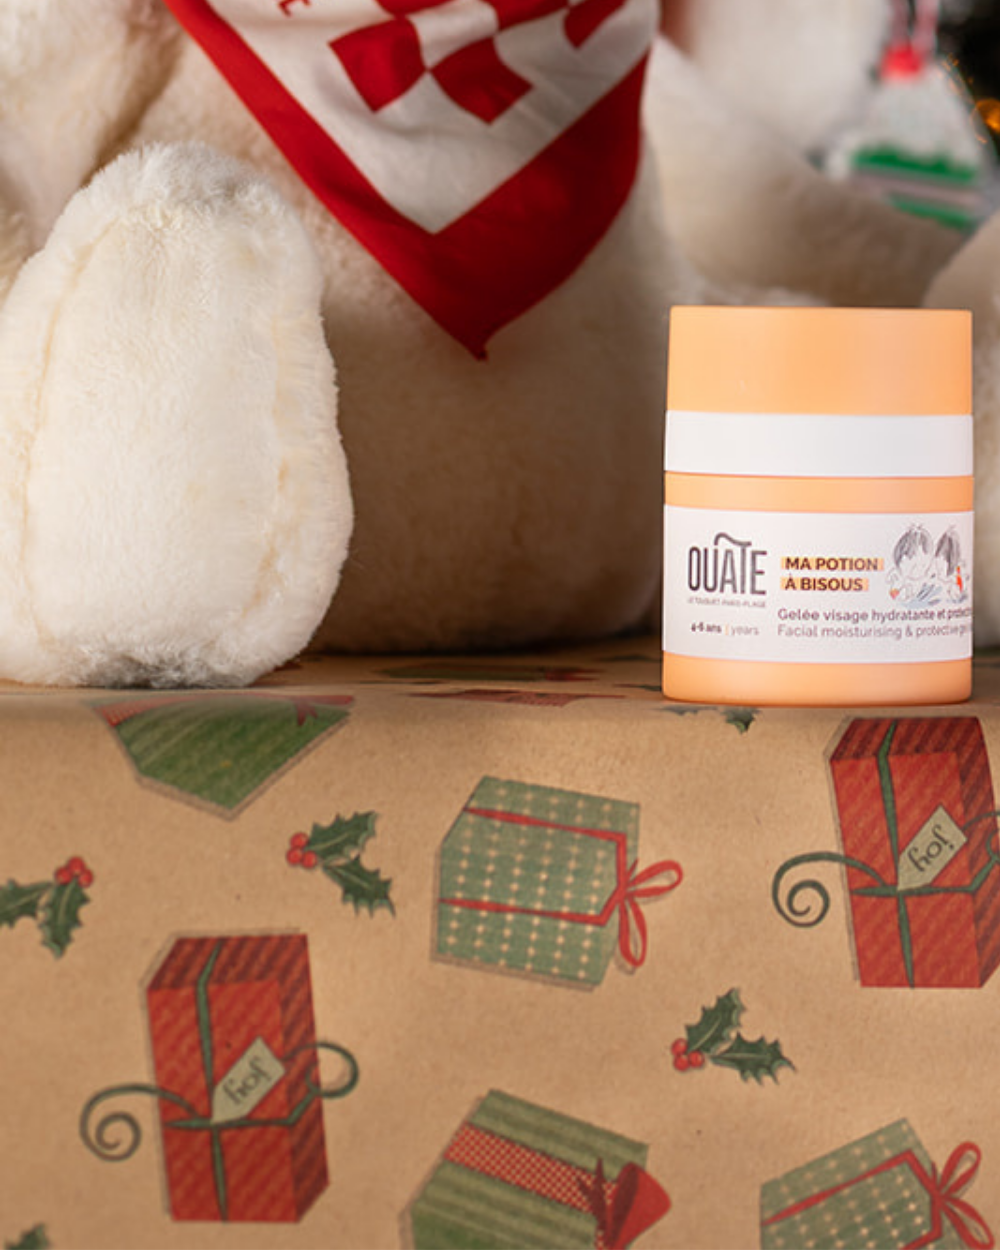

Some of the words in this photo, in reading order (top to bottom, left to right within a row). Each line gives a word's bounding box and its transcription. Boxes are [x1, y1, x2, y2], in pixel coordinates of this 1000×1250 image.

[688, 532, 768, 596] OUATE
[785, 557, 812, 571] MA
[815, 558, 879, 572] POTION
[785, 574, 797, 591] À
[800, 577, 864, 592] BISOUS
[777, 608, 820, 622] Gelée
[823, 609, 869, 624] visage
[871, 608, 936, 623] hydratante
[936, 609, 946, 619] et
[777, 624, 818, 638] Facial
[821, 625, 902, 640] moisturising
[905, 625, 914, 637] &
